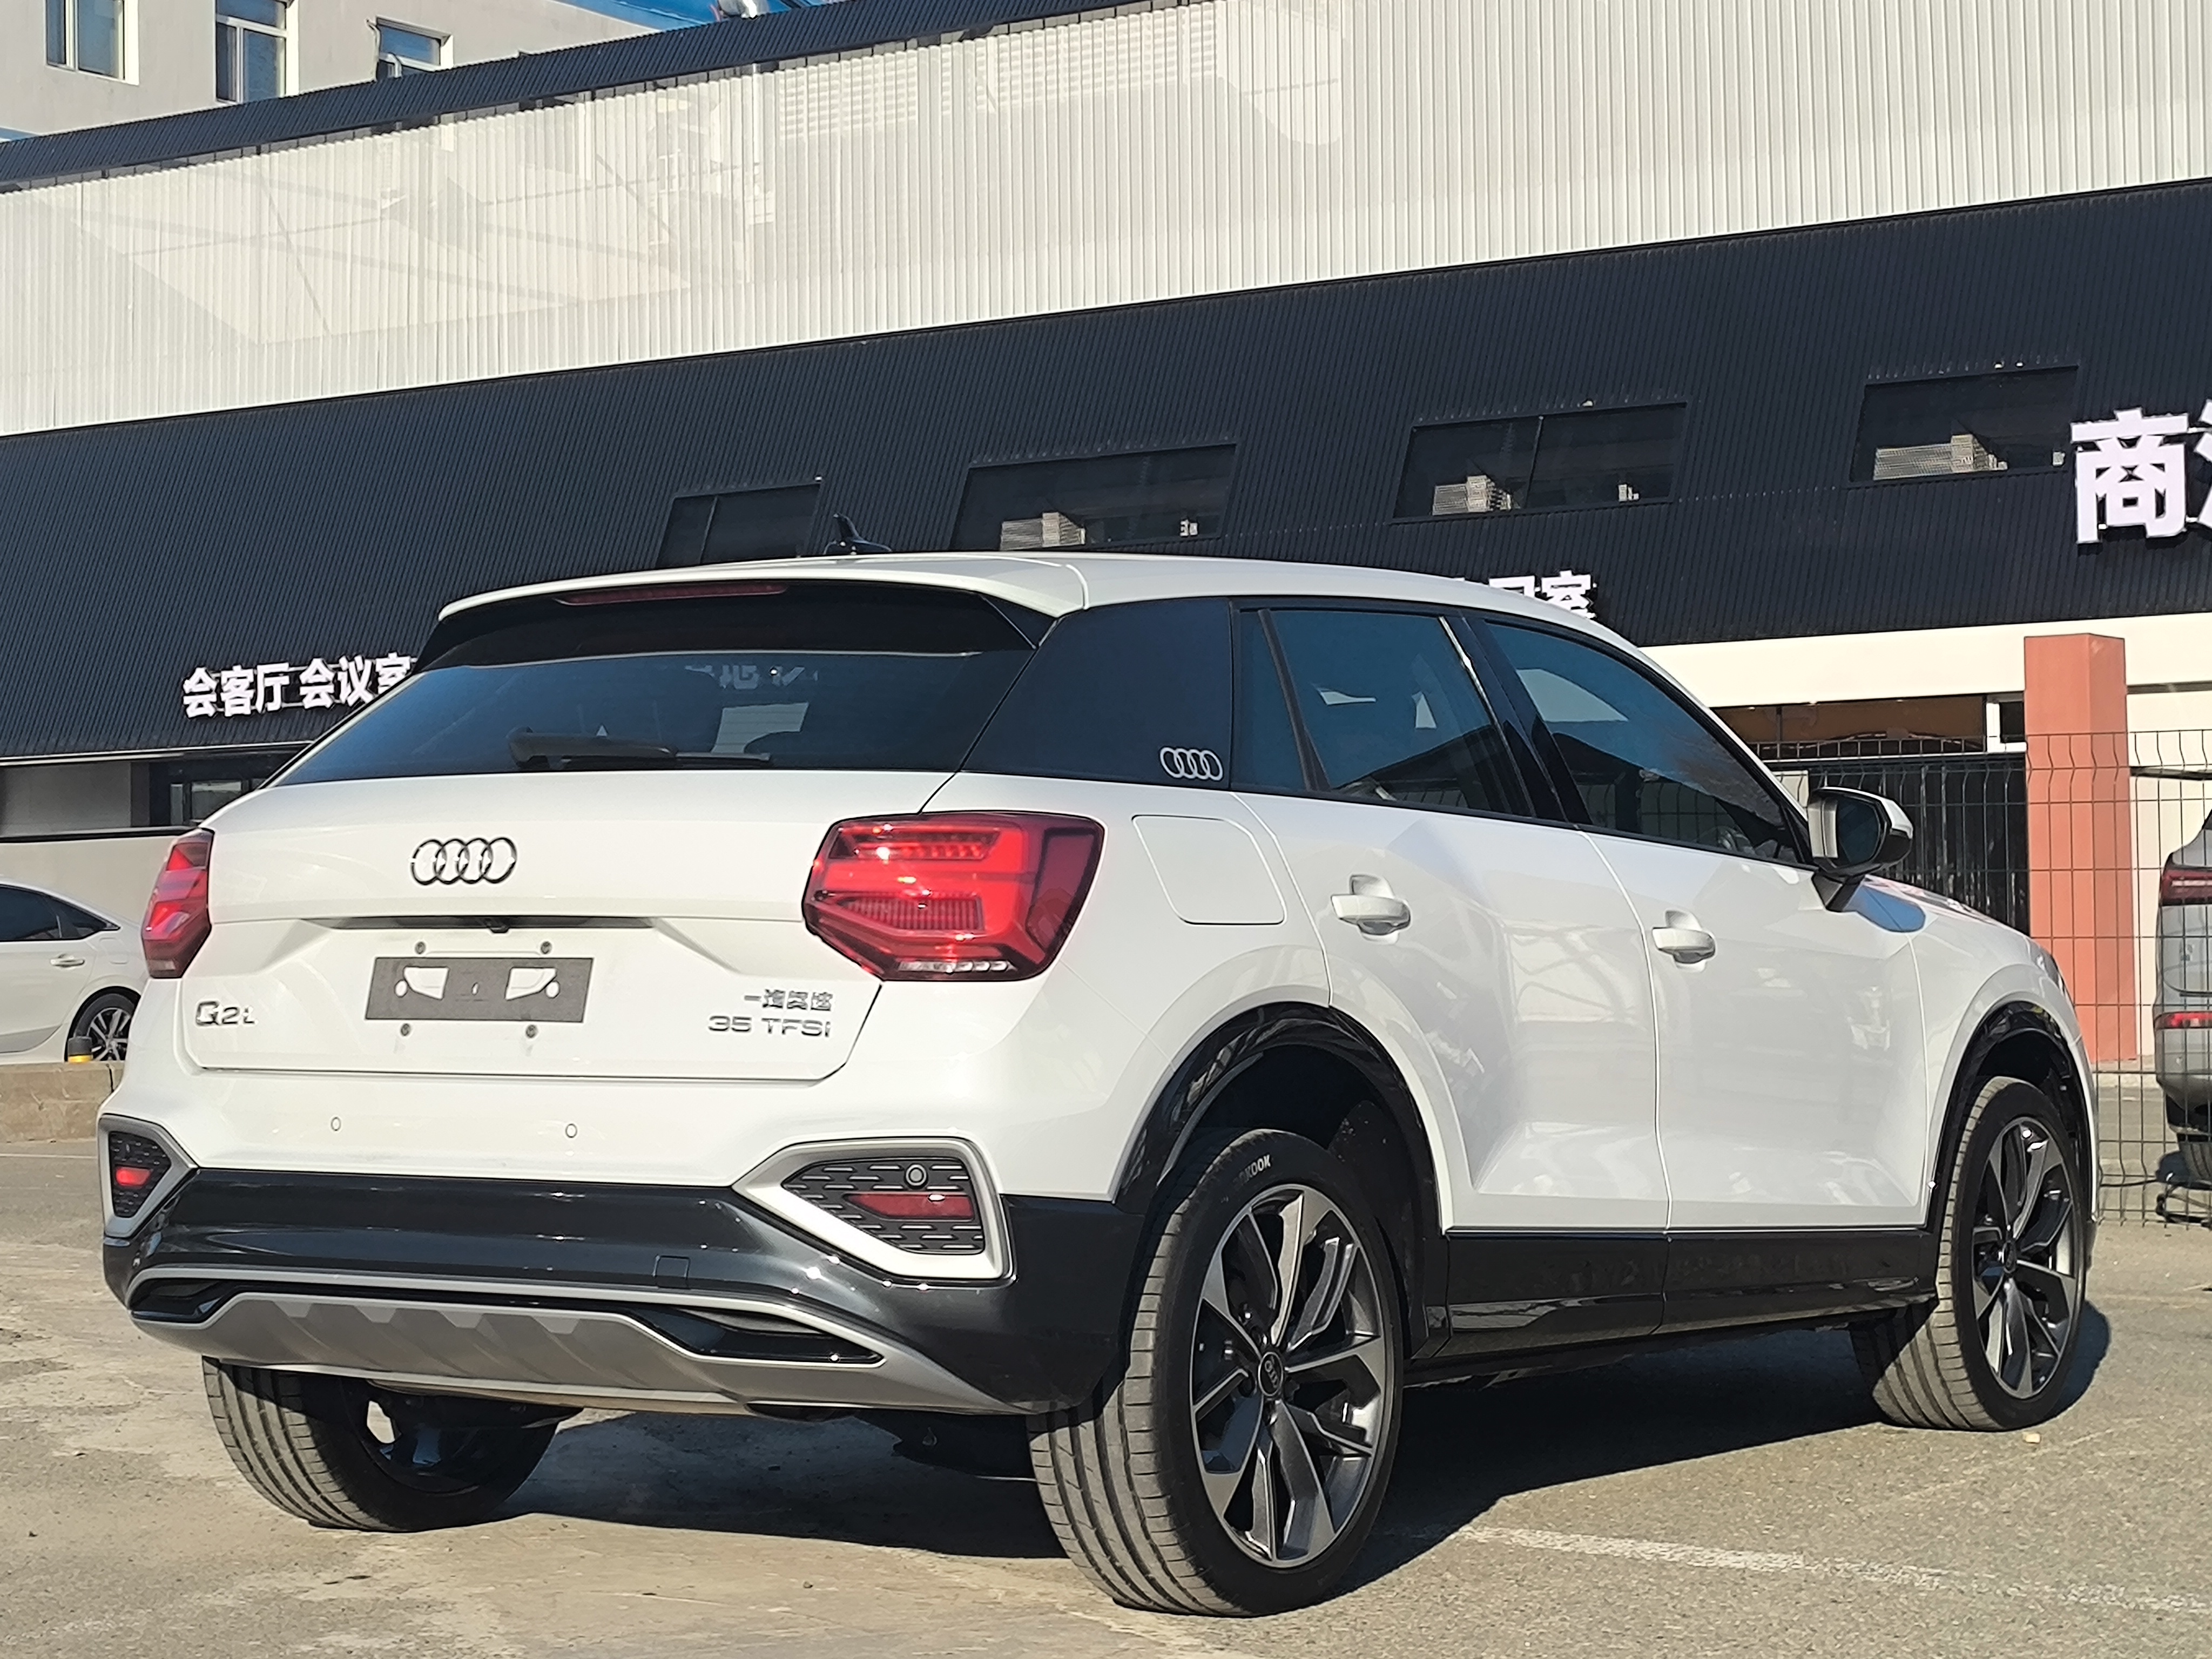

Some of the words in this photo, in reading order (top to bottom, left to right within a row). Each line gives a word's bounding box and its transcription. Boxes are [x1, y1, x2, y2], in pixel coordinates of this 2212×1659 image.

[2071, 399, 2212, 543] 商
[183, 662, 290, 718] 会客厅
[299, 652, 412, 709] 会议室
[196, 1001, 255, 1026] Q2L
[709, 1015, 752, 1032] 35
